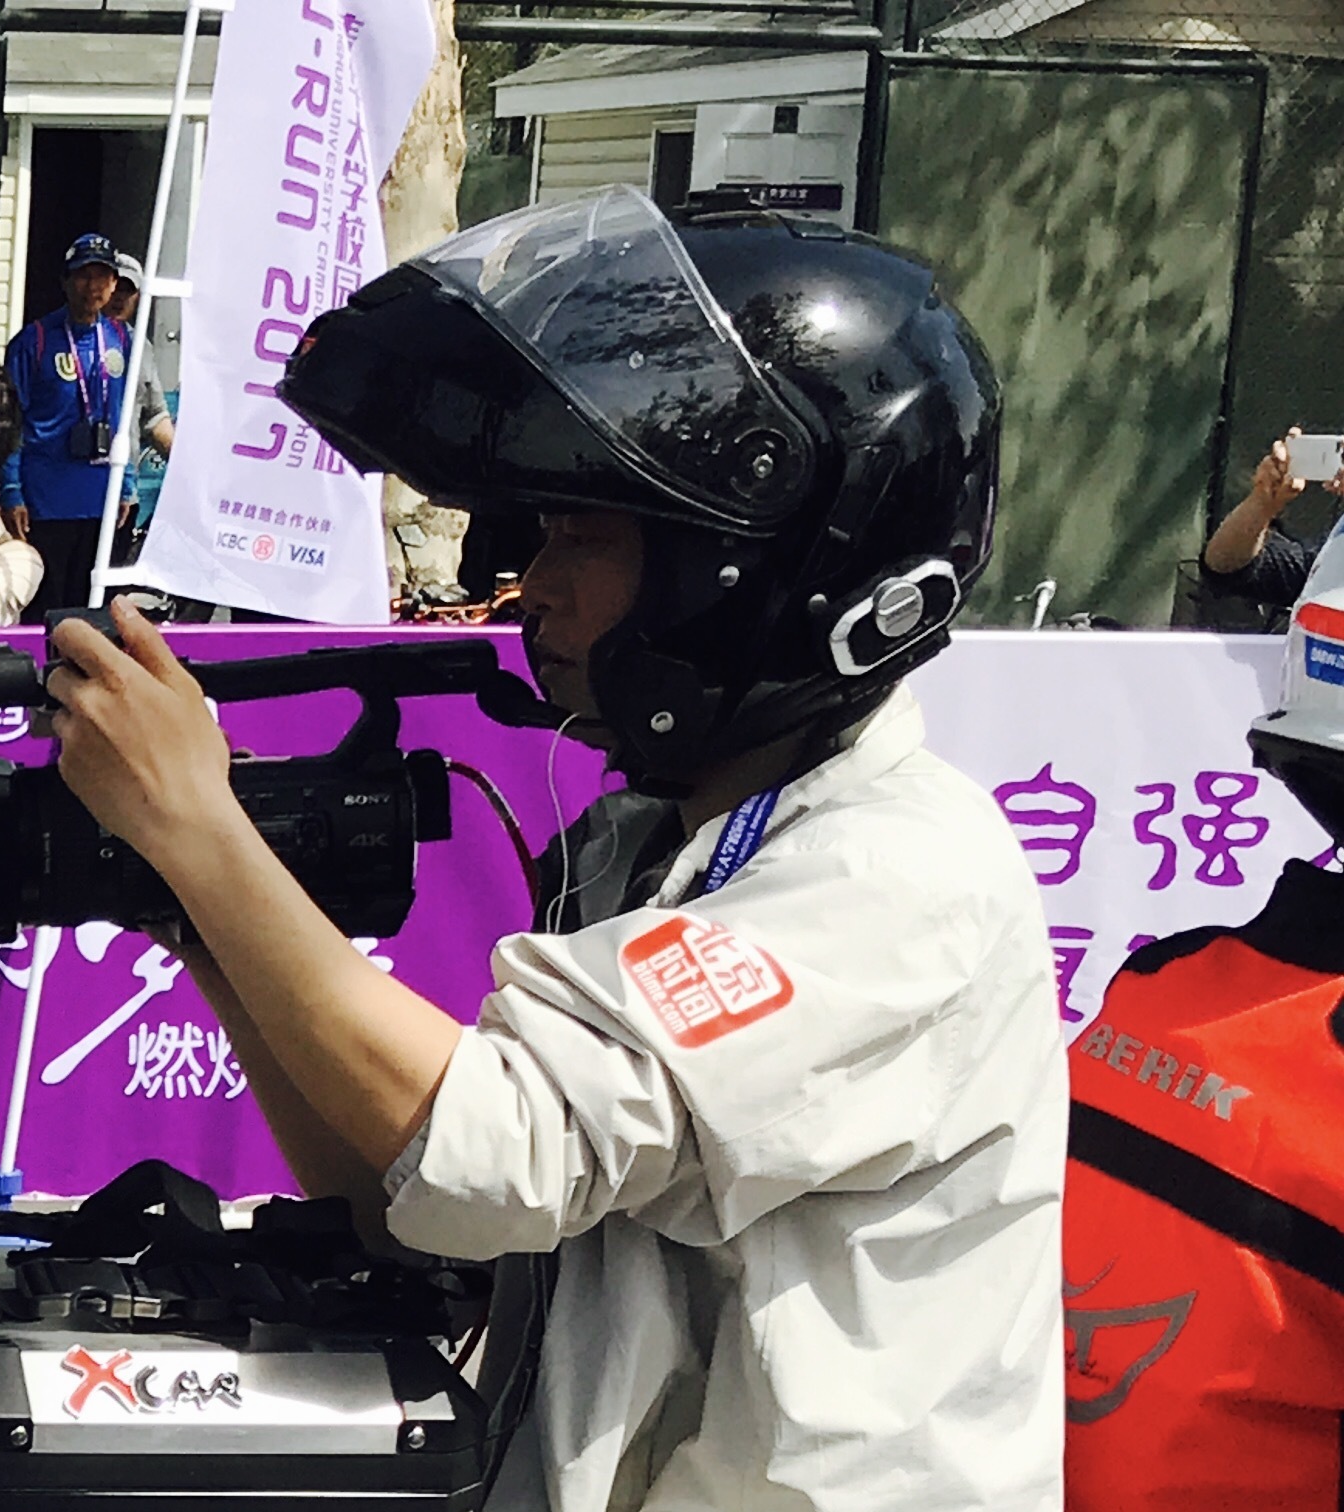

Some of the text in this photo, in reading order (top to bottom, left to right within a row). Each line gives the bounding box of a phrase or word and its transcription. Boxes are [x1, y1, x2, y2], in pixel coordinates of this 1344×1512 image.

[216, 531, 325, 567] ICBC VISA
[648, 942, 722, 1028] 时间
